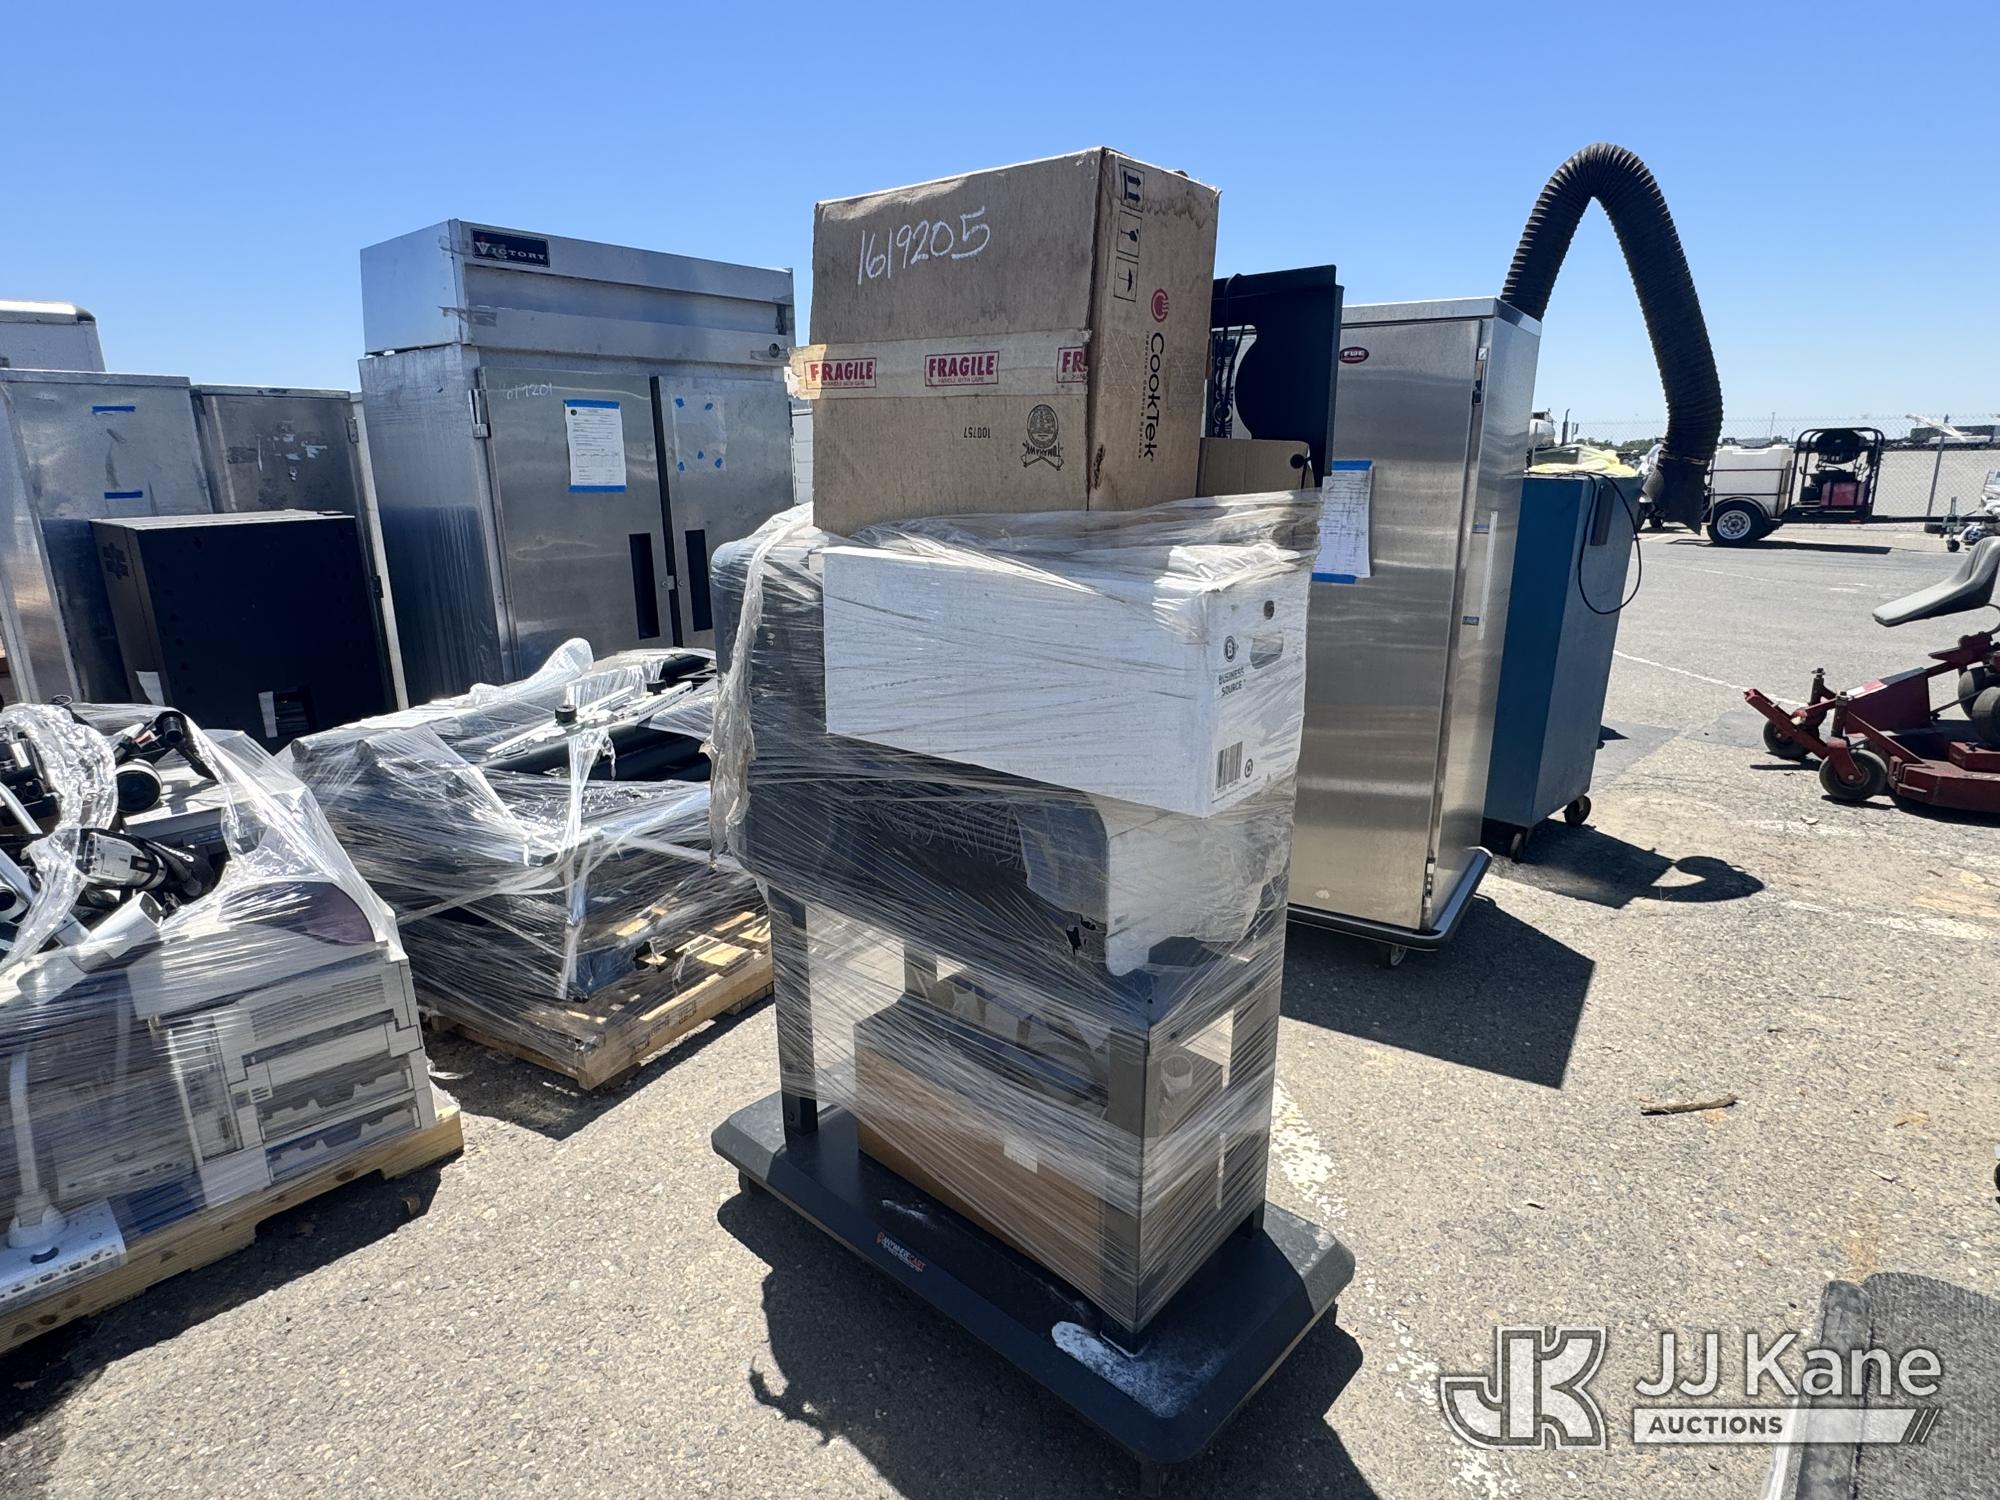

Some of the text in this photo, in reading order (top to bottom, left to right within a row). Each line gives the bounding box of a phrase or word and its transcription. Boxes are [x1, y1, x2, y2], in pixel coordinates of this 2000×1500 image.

[474, 240, 546, 260] VICTORY
[857, 205, 991, 286] 1619205
[810, 361, 874, 381] FRAGILE
[928, 355, 995, 378] FRAGILE
[1143, 332, 1165, 459] CookTek
